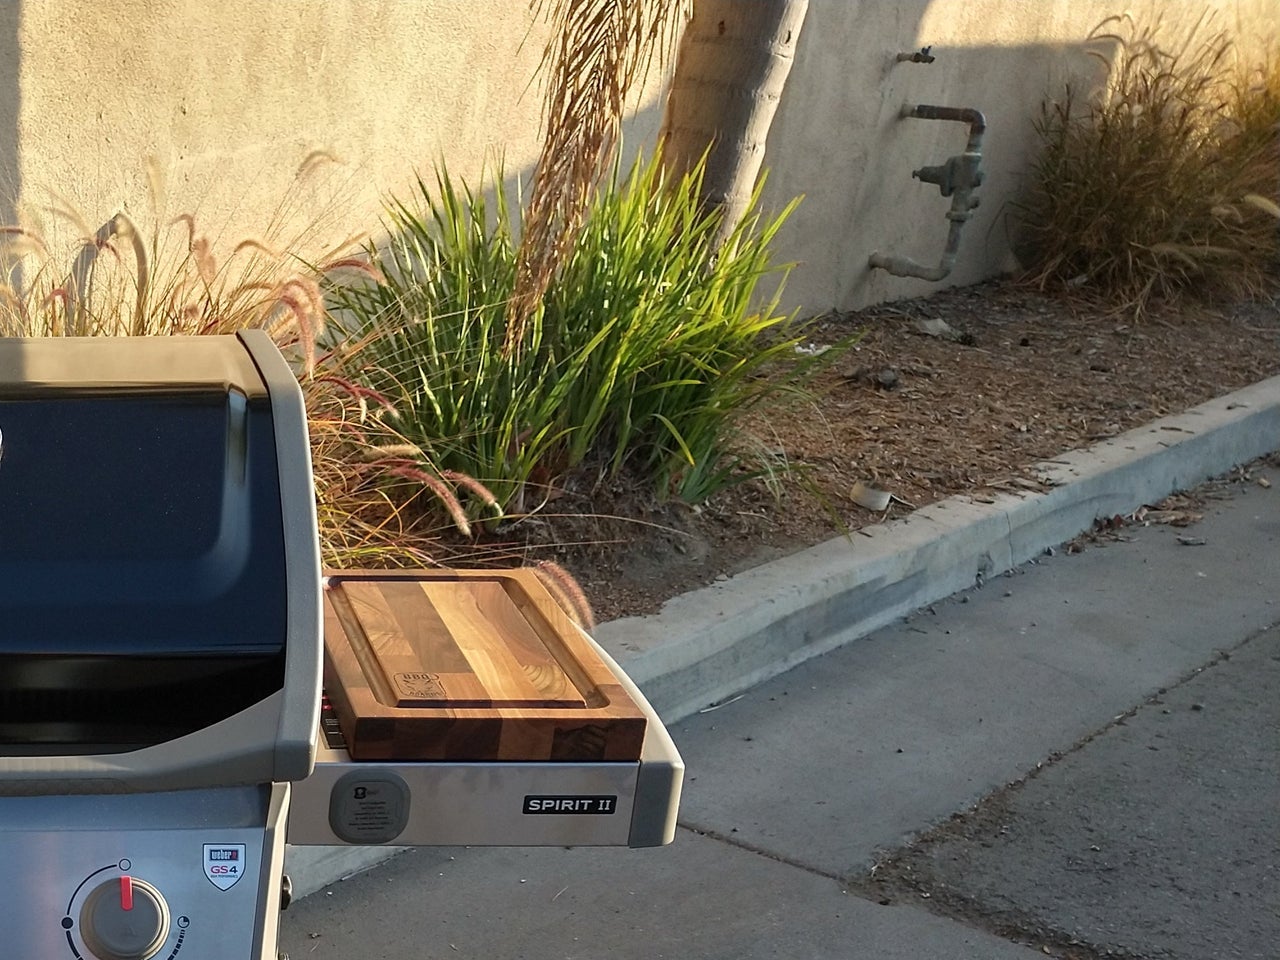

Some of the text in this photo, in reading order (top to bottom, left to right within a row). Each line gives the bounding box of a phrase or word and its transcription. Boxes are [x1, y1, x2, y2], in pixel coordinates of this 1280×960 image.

[528, 799, 611, 811] SPIRIT II
[211, 849, 231, 860] weber
[210, 865, 238, 874] GS4
